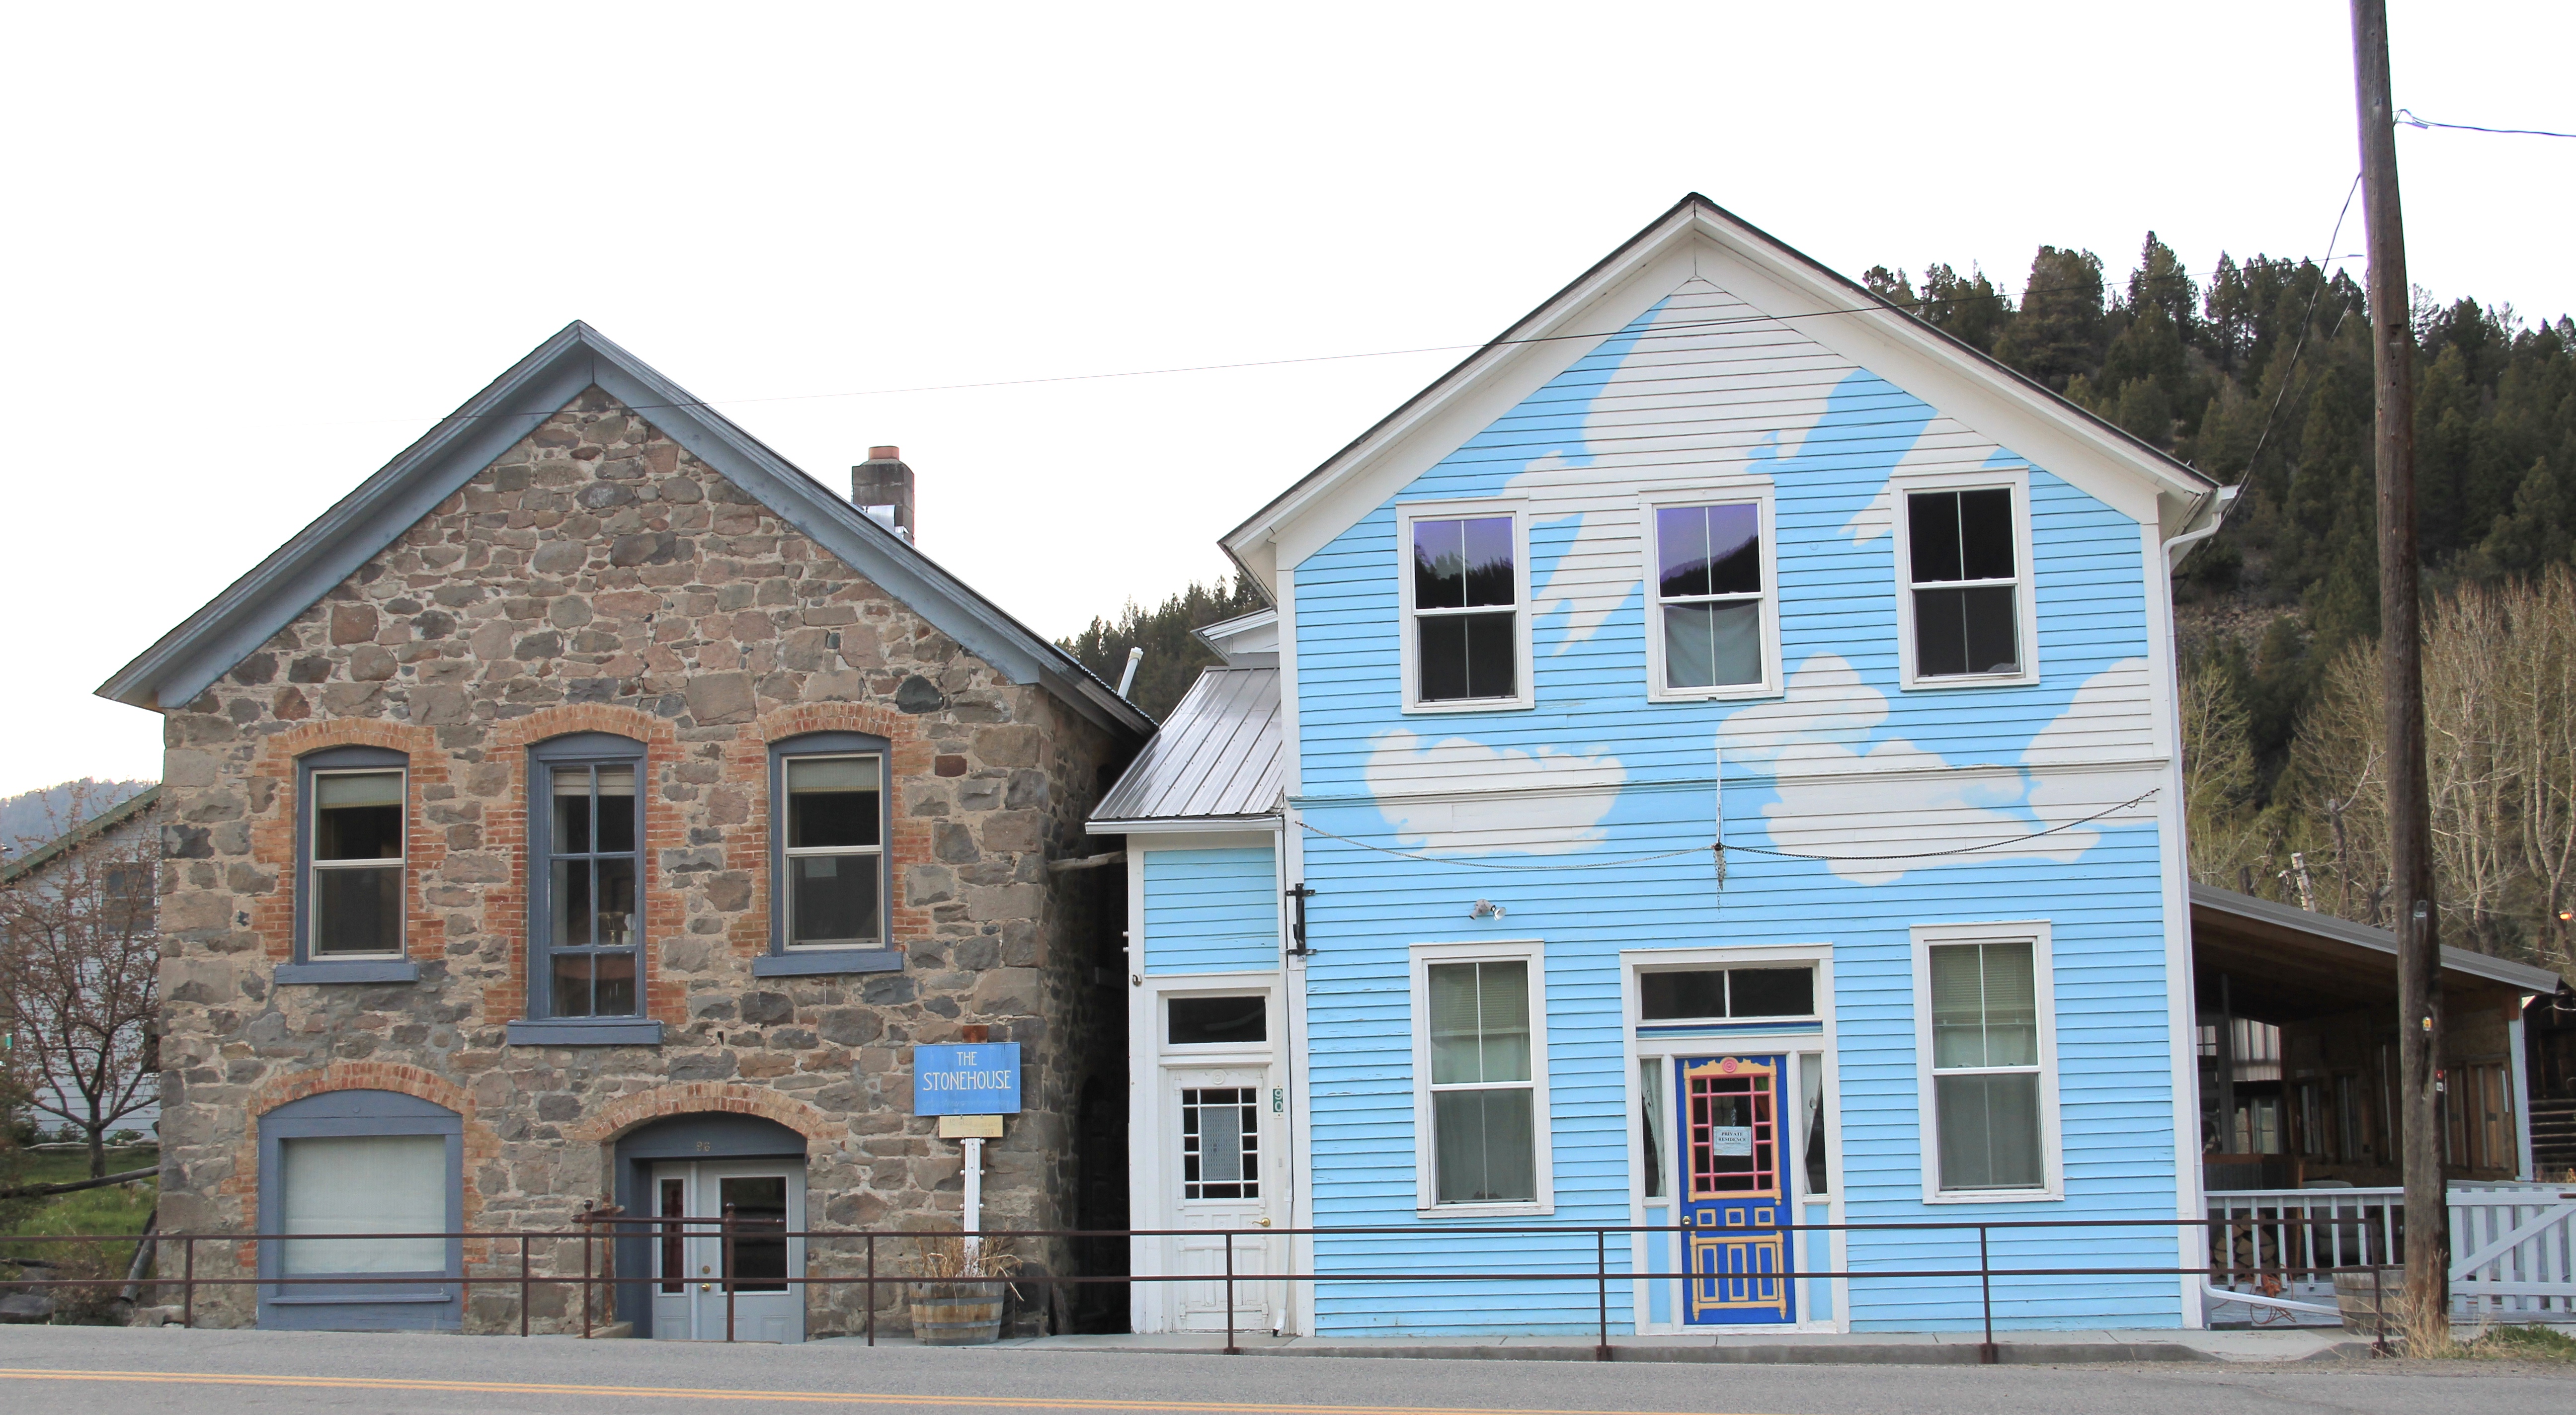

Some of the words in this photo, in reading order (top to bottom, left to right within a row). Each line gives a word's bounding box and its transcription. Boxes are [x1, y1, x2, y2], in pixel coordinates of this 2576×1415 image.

[956, 1051, 977, 1066] THE
[923, 1070, 1012, 1091] STONEHOUSE
[1274, 1089, 1283, 1112] 90
[697, 1141, 710, 1152] 96
